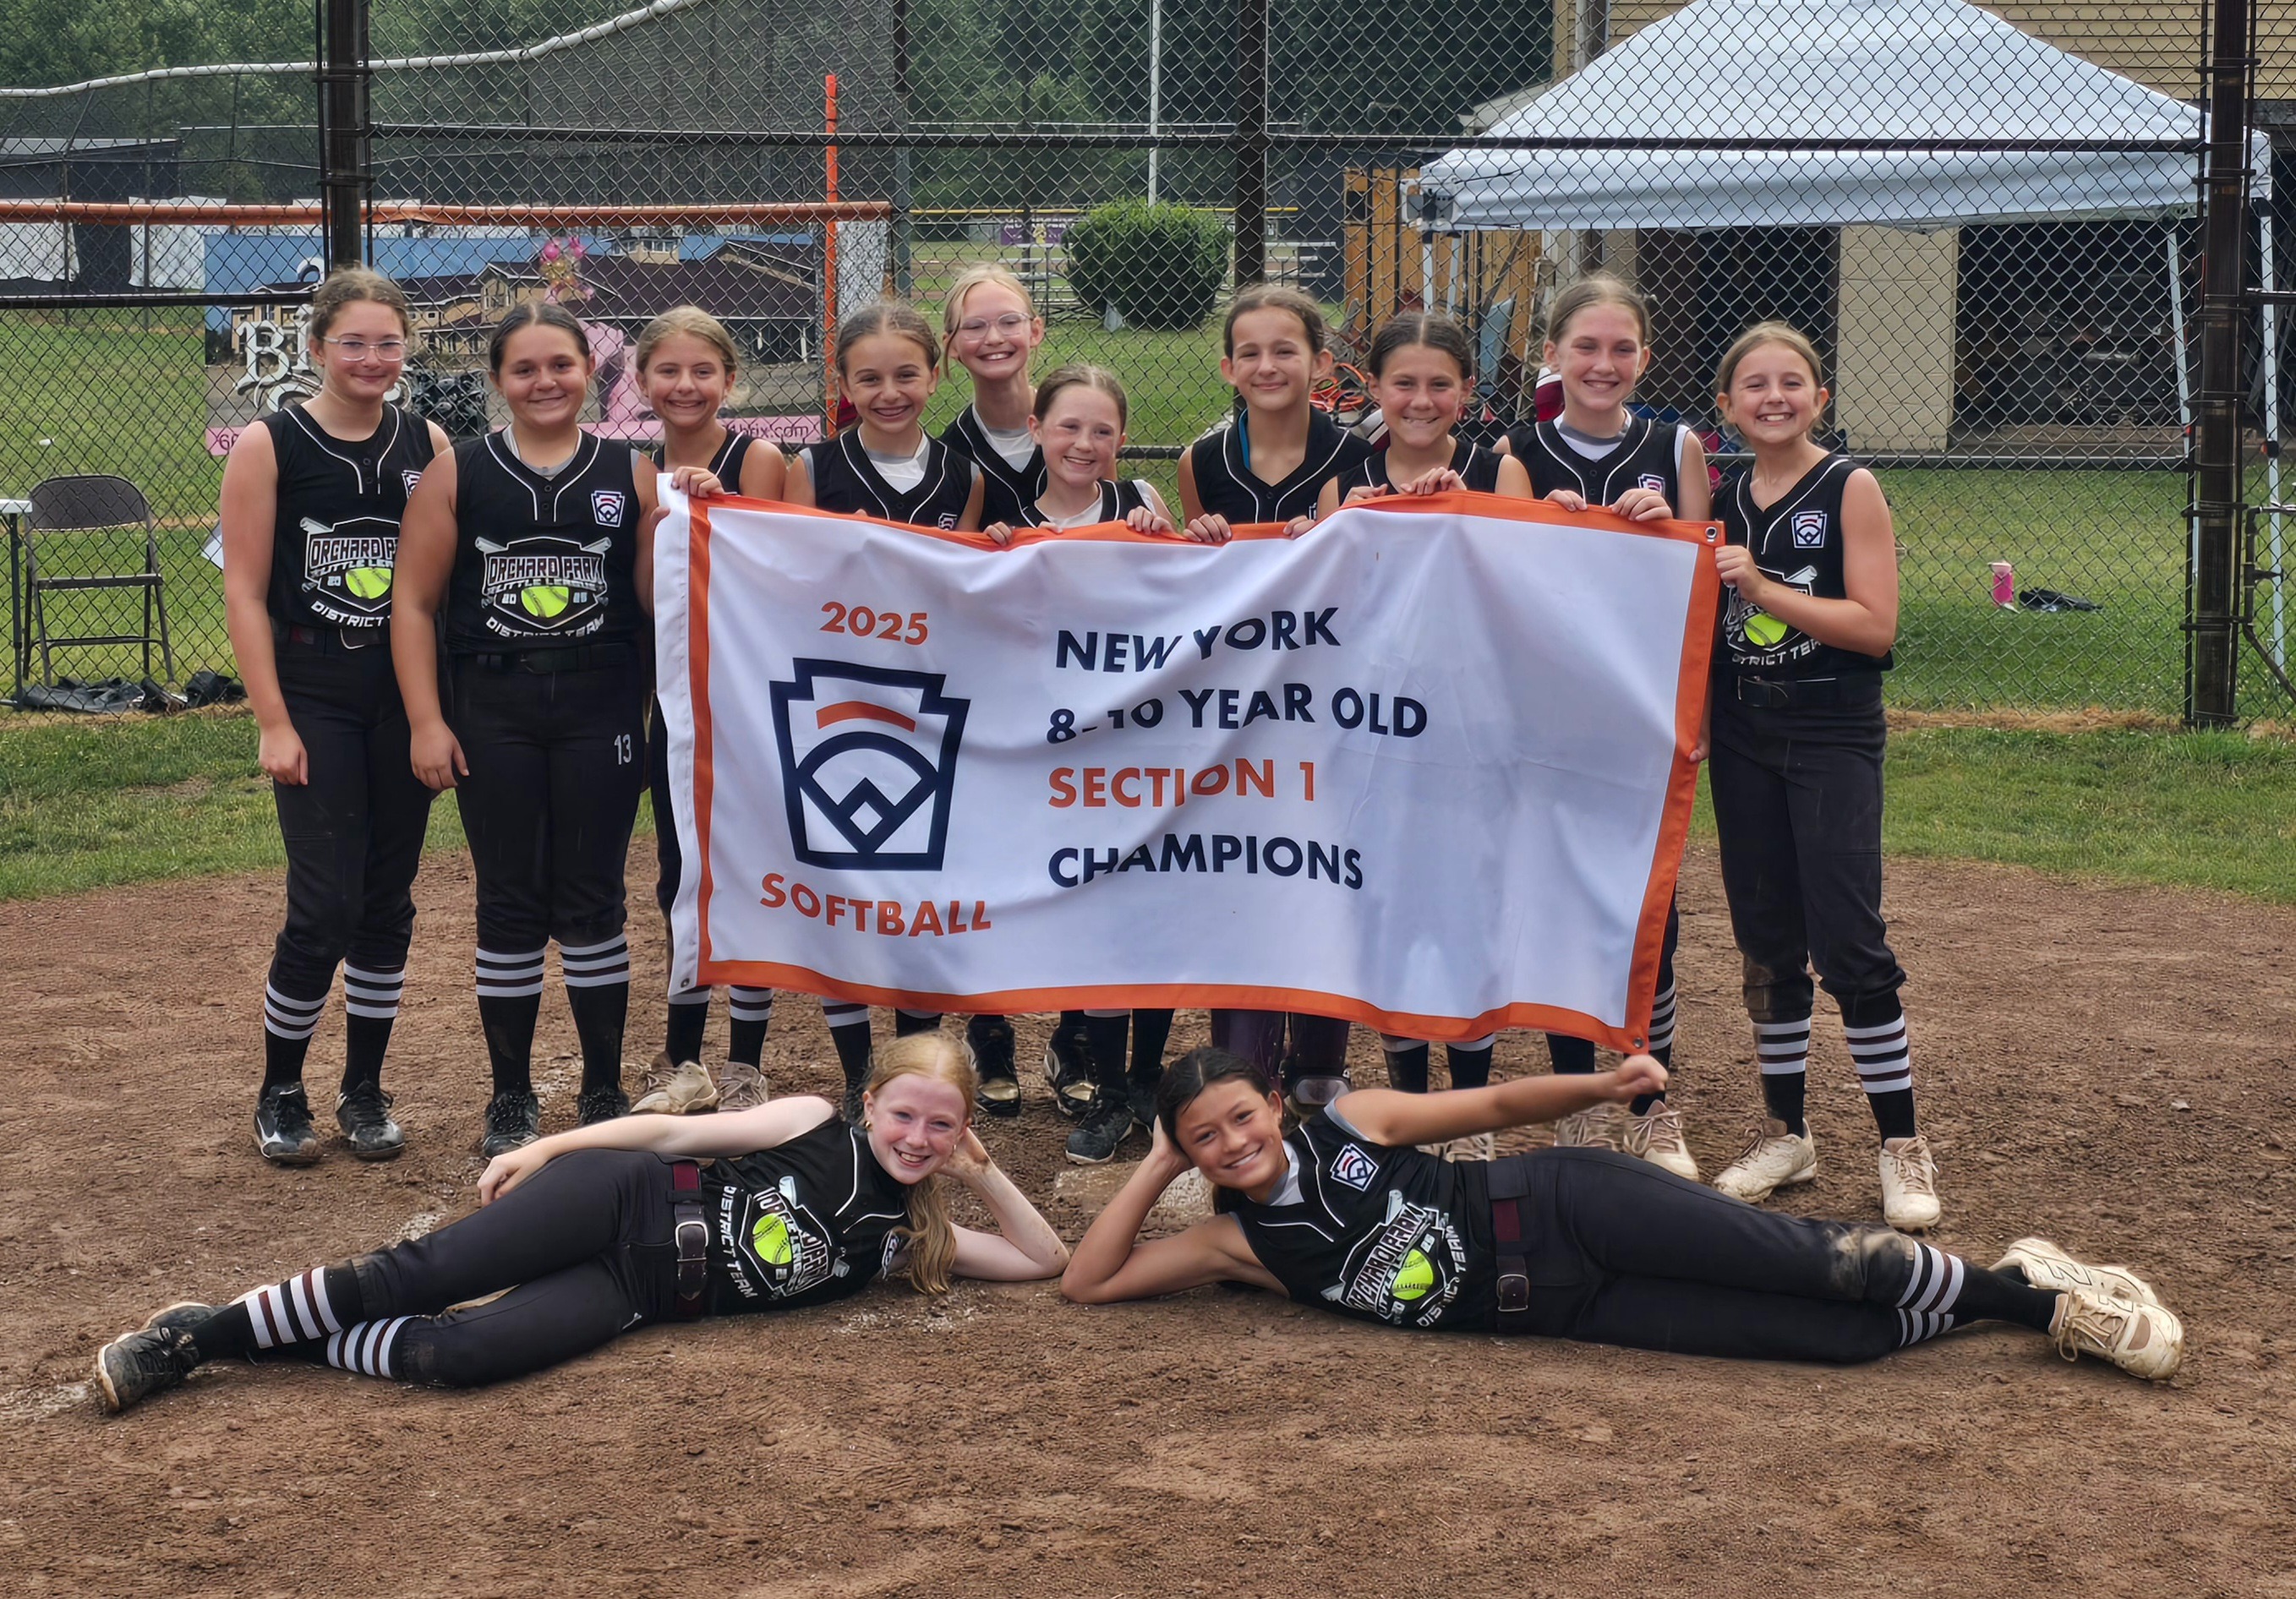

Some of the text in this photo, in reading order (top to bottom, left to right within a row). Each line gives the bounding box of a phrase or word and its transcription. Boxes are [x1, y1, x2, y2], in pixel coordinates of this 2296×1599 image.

[309, 538, 382, 569] ORCHARD
[488, 556, 603, 586] ORCHARD PARK
[310, 600, 384, 627] DISTRICT
[819, 601, 928, 645] 2025
[1055, 607, 1341, 673] NEW YORK
[1790, 638, 1821, 660] TEA
[1178, 683, 1316, 729] YEAR
[1331, 687, 1428, 738] OLD
[614, 734, 632, 765] 13
[1048, 758, 1315, 809] SECTION 1
[1048, 833, 1364, 890] CHAMPIONS
[760, 873, 992, 937] SOFTBALL
